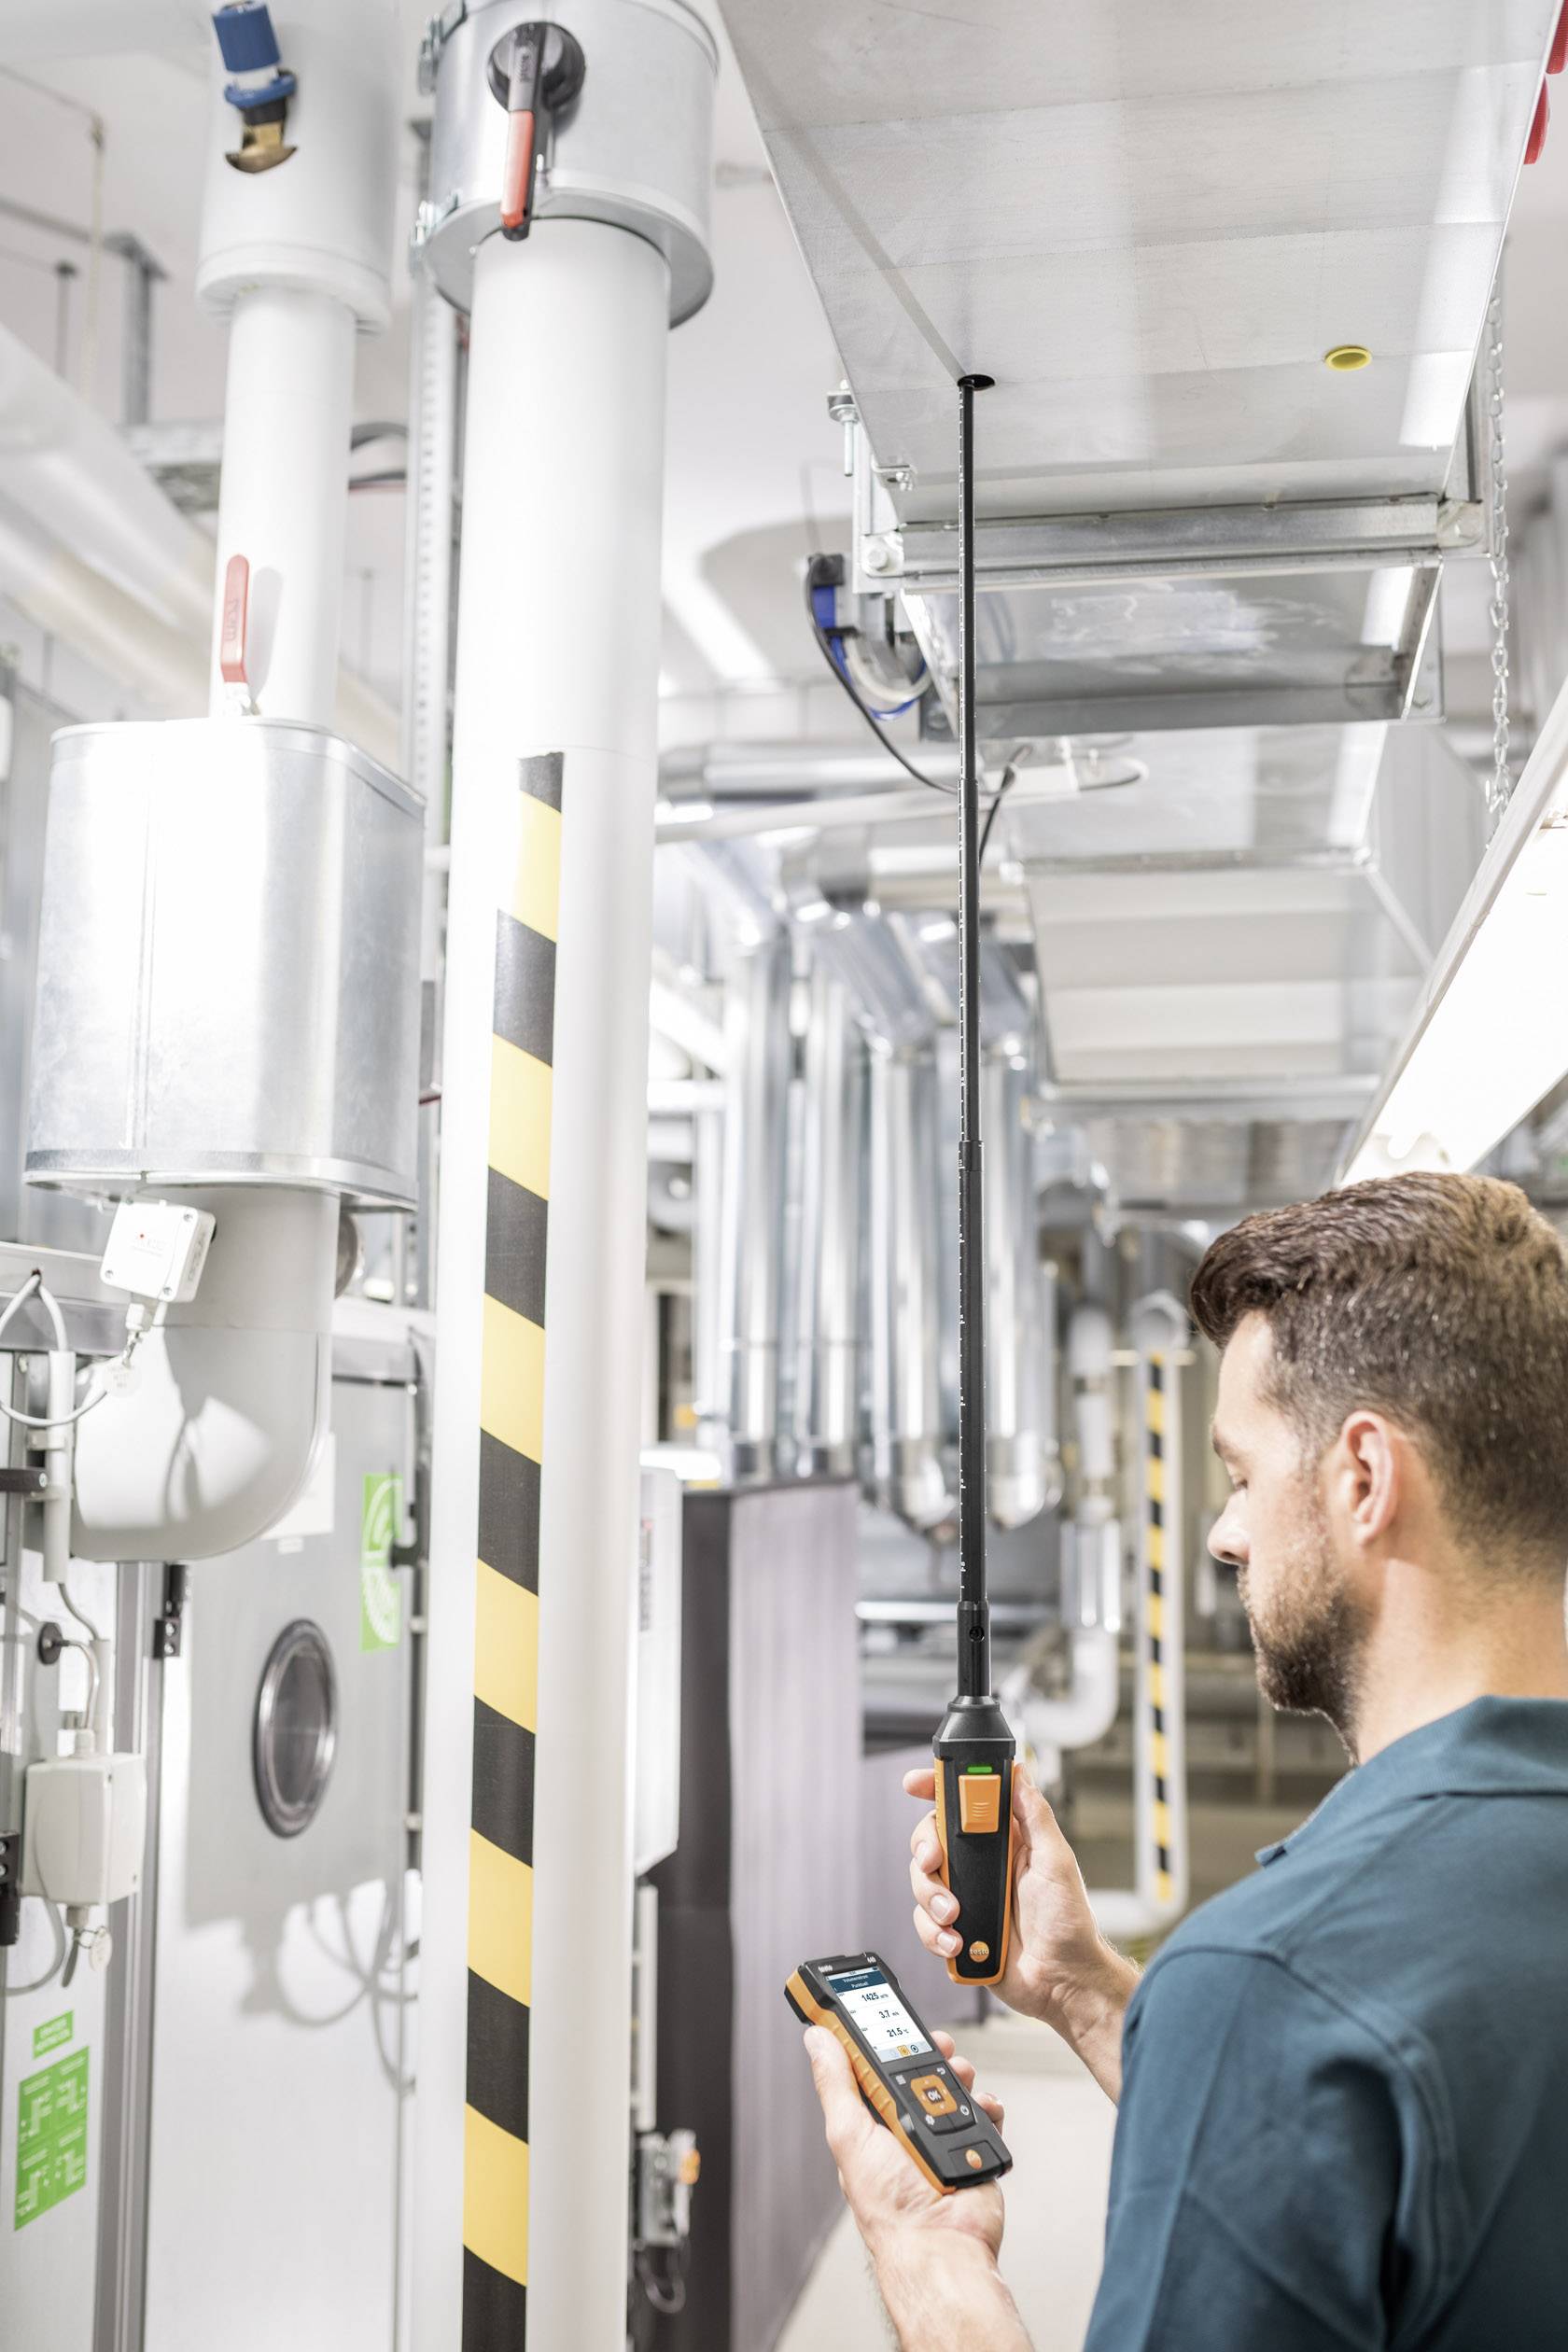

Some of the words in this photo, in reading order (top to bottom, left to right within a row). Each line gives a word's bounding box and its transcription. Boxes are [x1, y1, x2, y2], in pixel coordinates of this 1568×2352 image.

[970, 1948, 989, 1956] testo
[861, 1993, 879, 2002] 1425
[879, 2009, 890, 2019] 3.7
[887, 2027, 903, 2037] 21.5
[927, 2090, 942, 2101] OK
